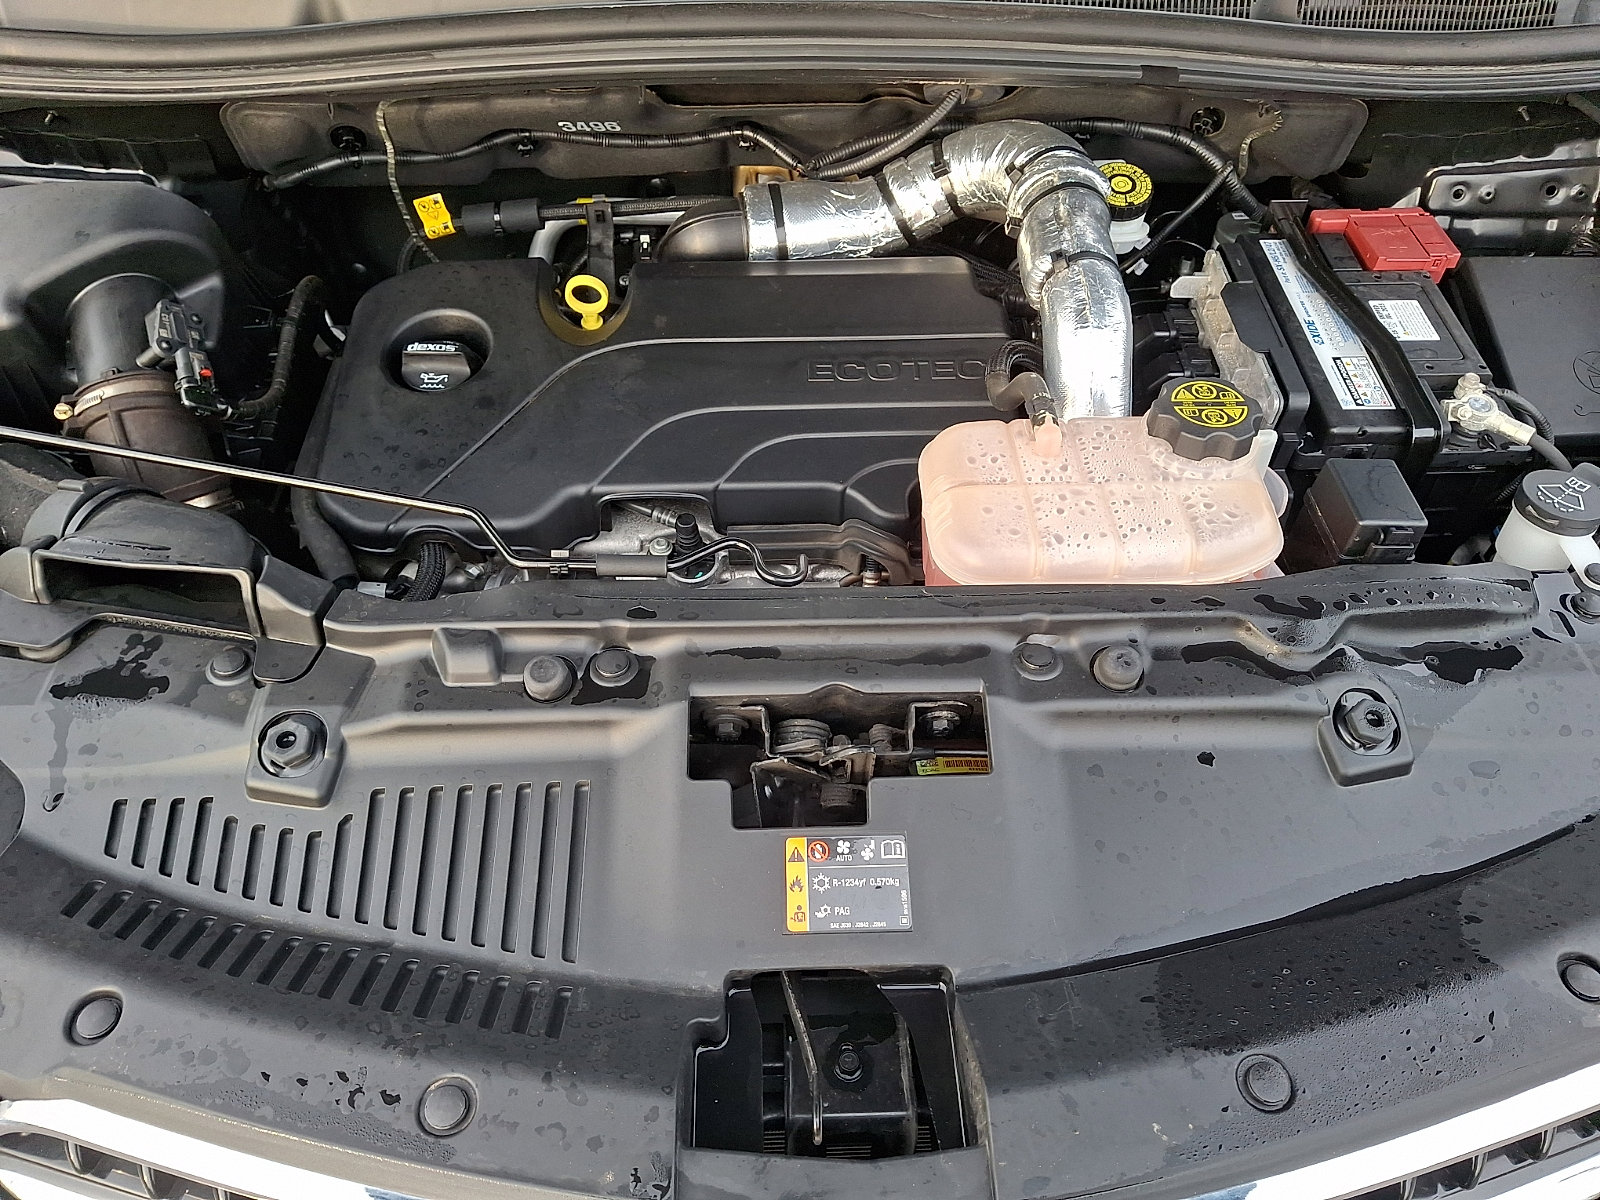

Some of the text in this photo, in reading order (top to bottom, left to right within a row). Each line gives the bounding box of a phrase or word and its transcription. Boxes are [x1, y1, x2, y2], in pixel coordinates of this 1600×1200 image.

[557, 120, 621, 132] 3496
[1303, 318, 1325, 346] EXIDE
[406, 342, 458, 352] dexos
[807, 359, 987, 382] ECOTEC
[835, 854, 853, 862] AUTO
[832, 877, 900, 888] R-1234yf 0.570kg
[834, 906, 850, 915] PAG
